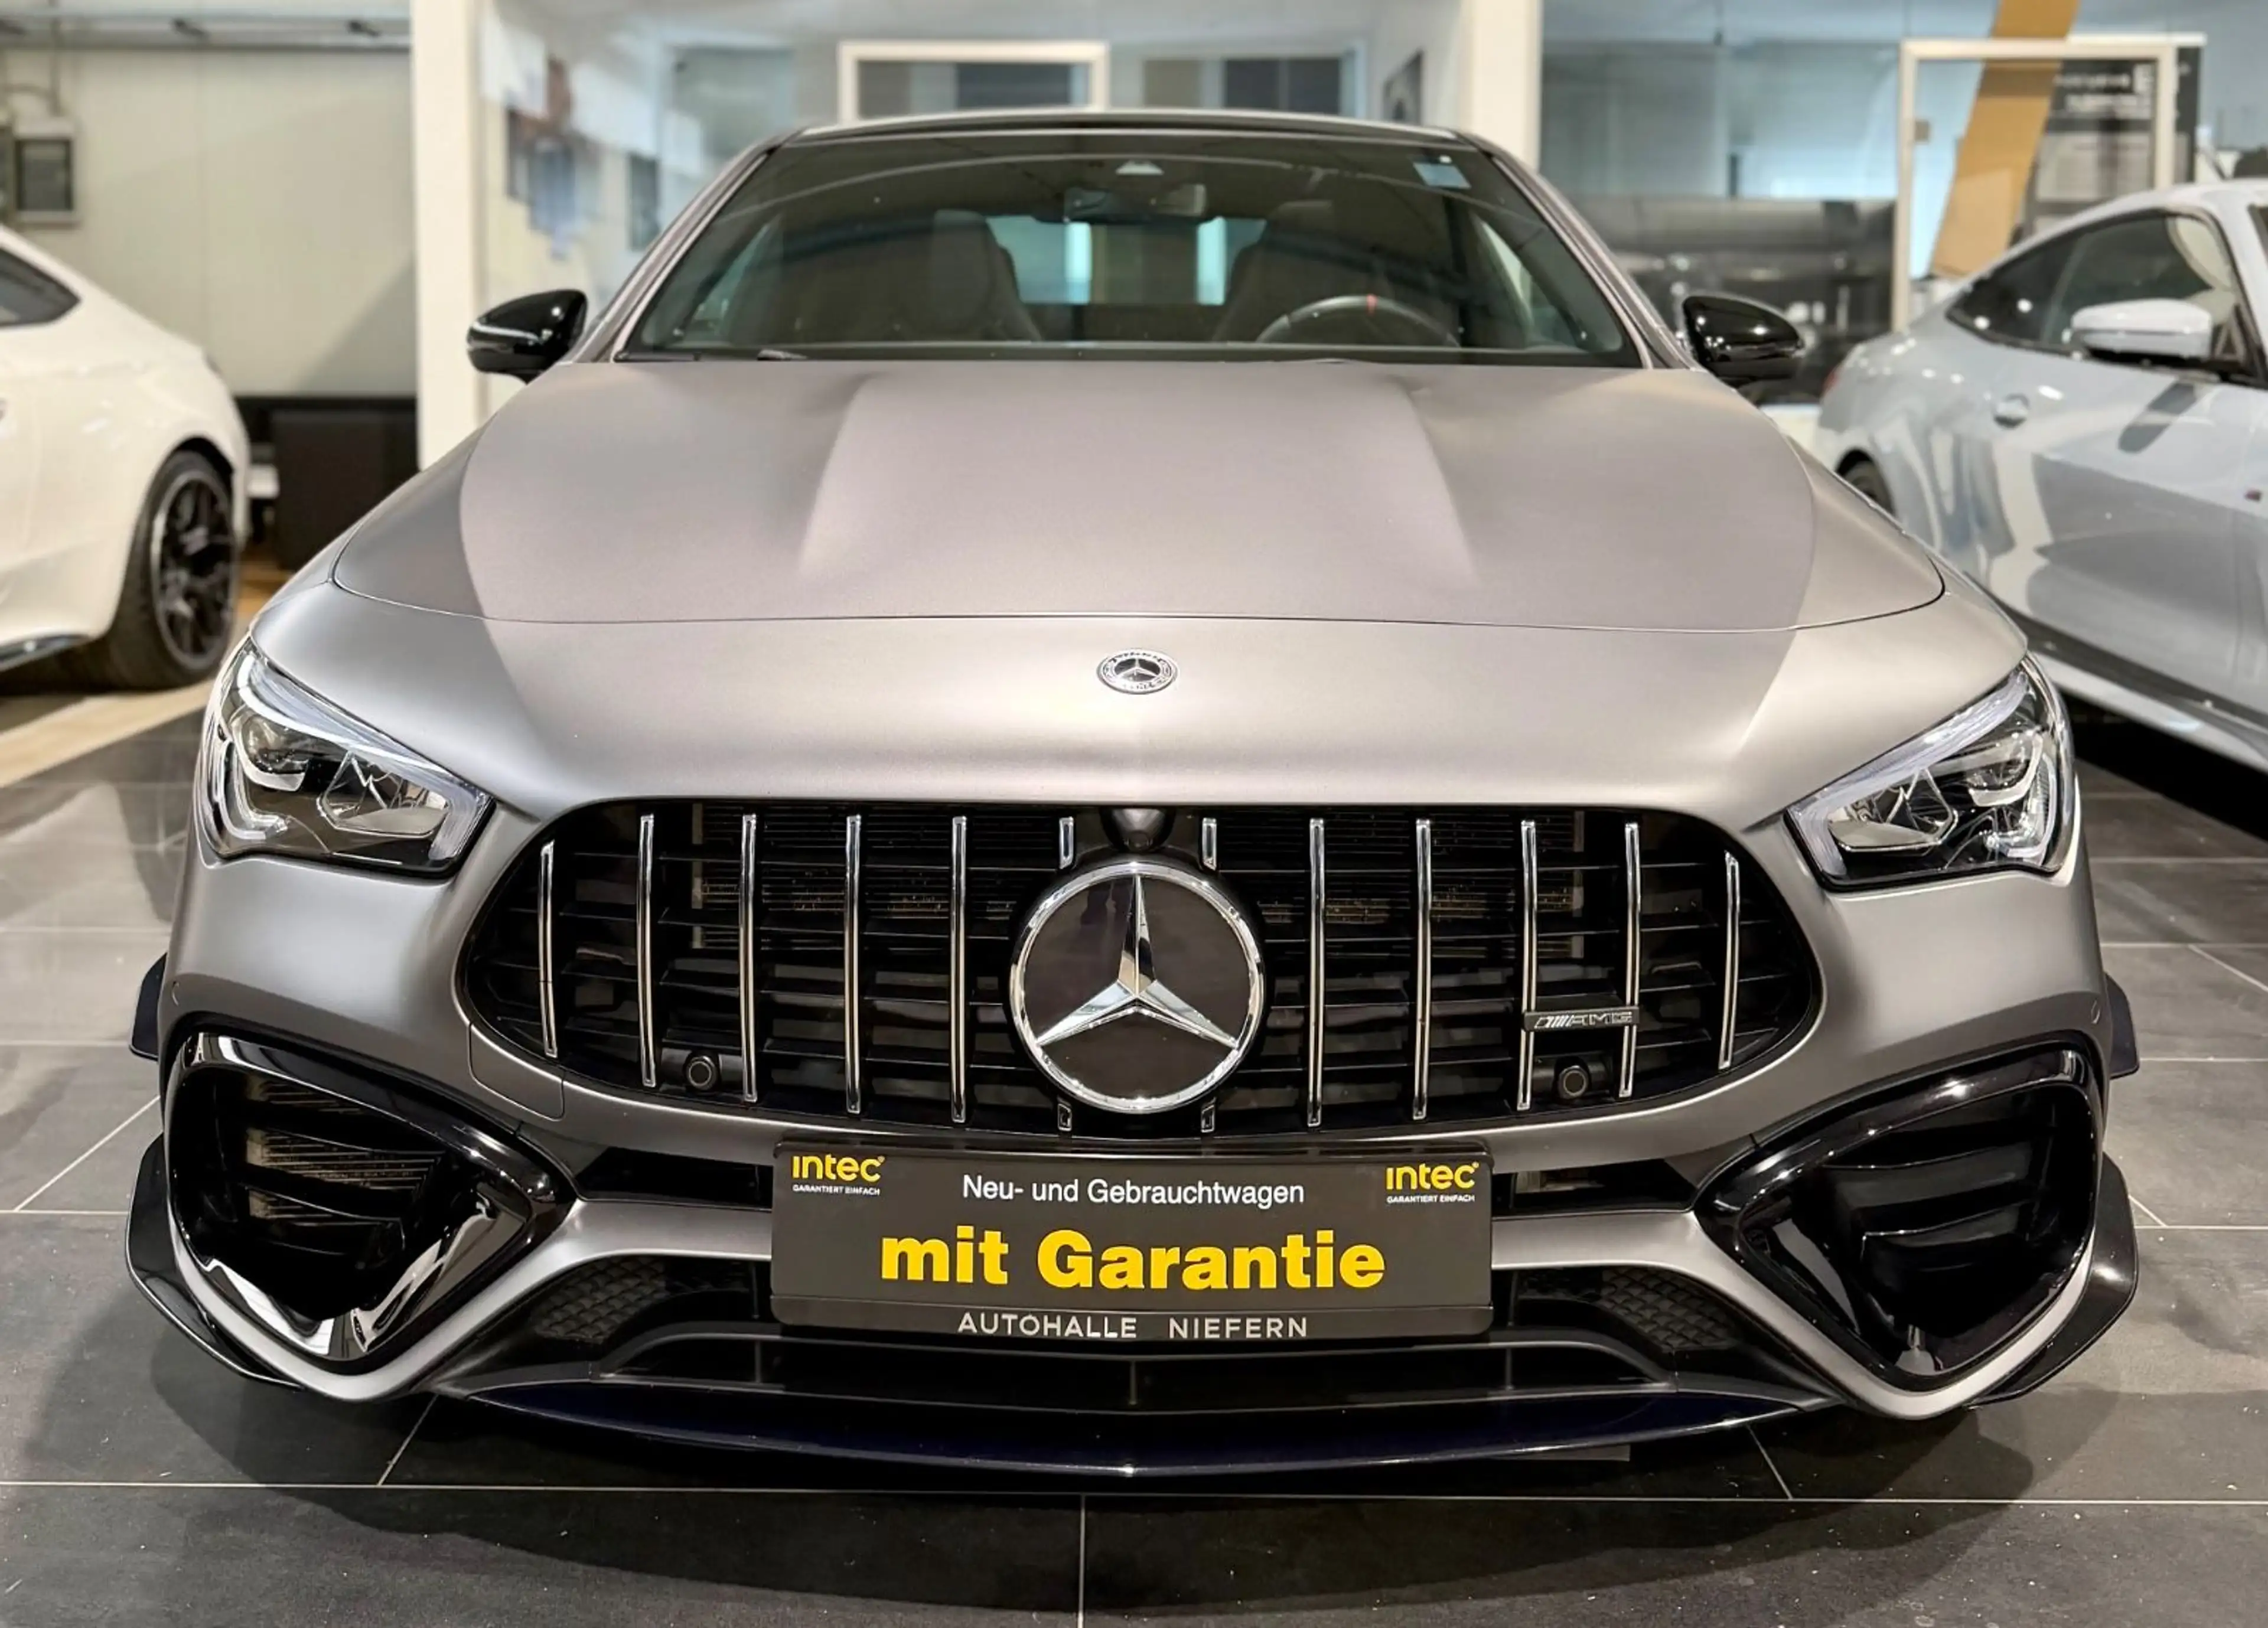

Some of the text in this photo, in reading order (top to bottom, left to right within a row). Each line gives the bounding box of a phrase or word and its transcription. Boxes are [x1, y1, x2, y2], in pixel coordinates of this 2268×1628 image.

[1567, 1011, 1633, 1027] AMG
[792, 1183, 880, 1196] GARANTIERT EINFACH
[963, 1174, 1304, 1209] Neu- und Gebrauchtwagen
[1387, 1193, 1475, 1204] GARANTIERT EINFACH
[881, 1225, 1385, 1290] mit Garantie
[958, 1312, 1308, 1339] AUTOHALLE NIEFERN
